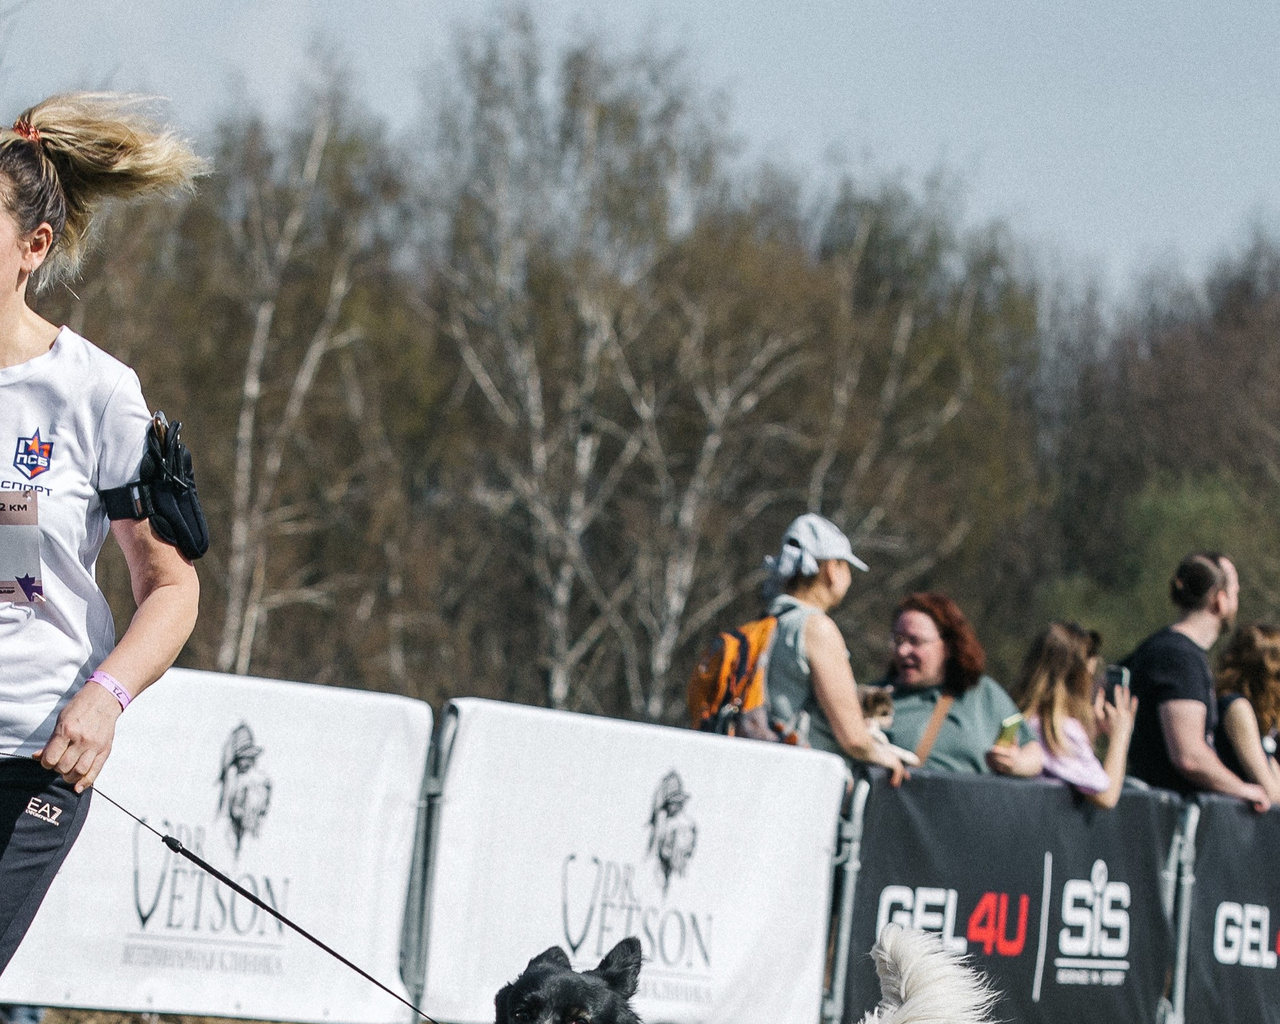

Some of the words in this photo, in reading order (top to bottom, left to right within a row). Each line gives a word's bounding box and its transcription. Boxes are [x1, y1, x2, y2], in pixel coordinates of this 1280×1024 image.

[16, 453, 49, 467] ПСБ
[1, 480, 54, 497] СПОРТ
[27, 796, 63, 821] EA7
[1213, 901, 1280, 969] GEL
